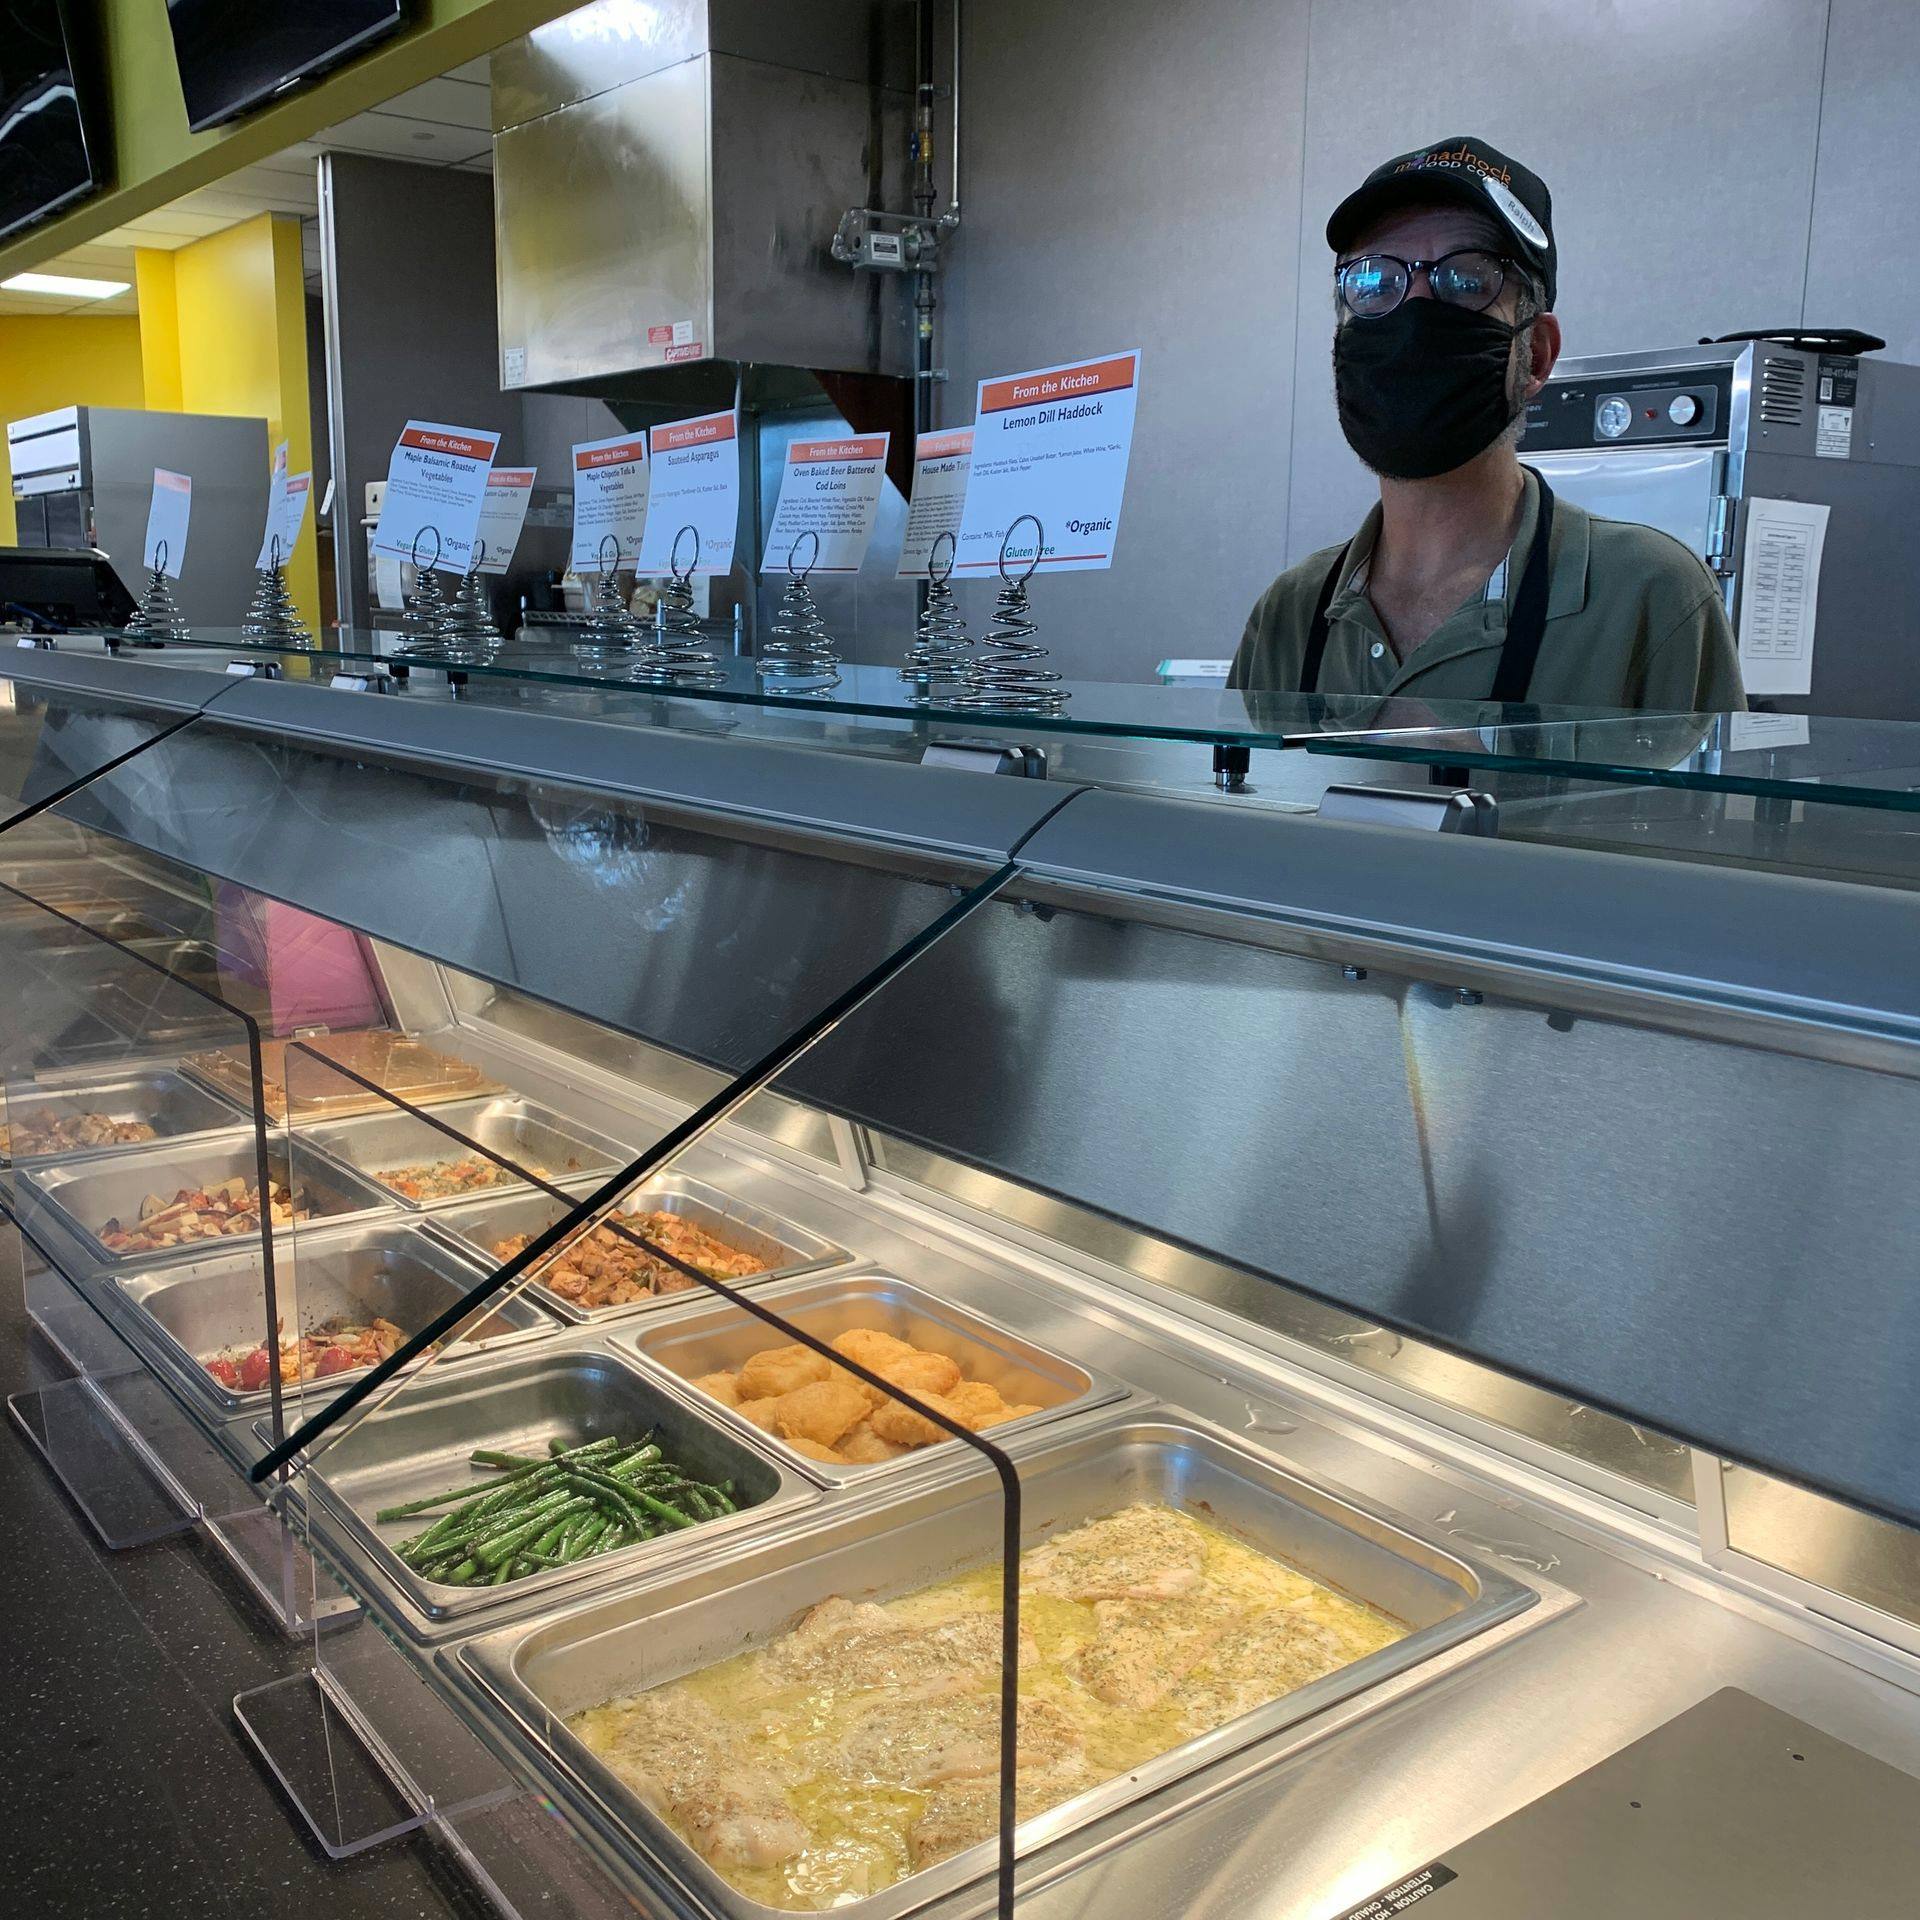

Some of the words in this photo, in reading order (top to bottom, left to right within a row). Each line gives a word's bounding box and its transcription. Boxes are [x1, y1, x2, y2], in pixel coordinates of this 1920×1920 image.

[1508, 201, 1535, 232] Ralph
[1012, 386, 1039, 400] From
[1042, 380, 1058, 394] the
[1060, 374, 1100, 390] Kitchen
[1003, 416, 1036, 430] Lemon
[1038, 410, 1056, 424] Dill
[1058, 402, 1104, 420] Haddock
[669, 432, 684, 443] From
[685, 430, 694, 439] the
[695, 426, 717, 438] Kitchen
[420, 435, 436, 446] From
[437, 438, 446, 448] the
[448, 440, 472, 452] Kitchen
[810, 447, 826, 457] From
[827, 446, 838, 455] the
[839, 445, 864, 455] Kitchen
[404, 452, 422, 464] Maple
[423, 454, 450, 468] Balsamic
[451, 460, 477, 473] Roasted
[591, 454, 603, 463] From
[612, 450, 629, 459] Kitchen
[668, 453, 689, 466] Sauteed
[690, 450, 719, 463] Asparagus
[422, 468, 453, 483] Vegetables
[586, 472, 600, 482] Maple
[601, 470, 620, 479] Chipotle
[794, 468, 809, 477] Oven
[811, 467, 829, 476] Baked
[830, 466, 846, 475] Beer
[847, 464, 876, 475] Battered
[922, 466, 939, 475] House
[940, 462, 956, 473] Made
[600, 482, 624, 493] Vegetables
[816, 481, 829, 490] Cod
[829, 481, 846, 490] Loins
[1005, 547, 1033, 558] Gluten
[1384, 1870, 1432, 1902] ATTENTION
[1394, 1884, 1434, 1910] CAUTION
